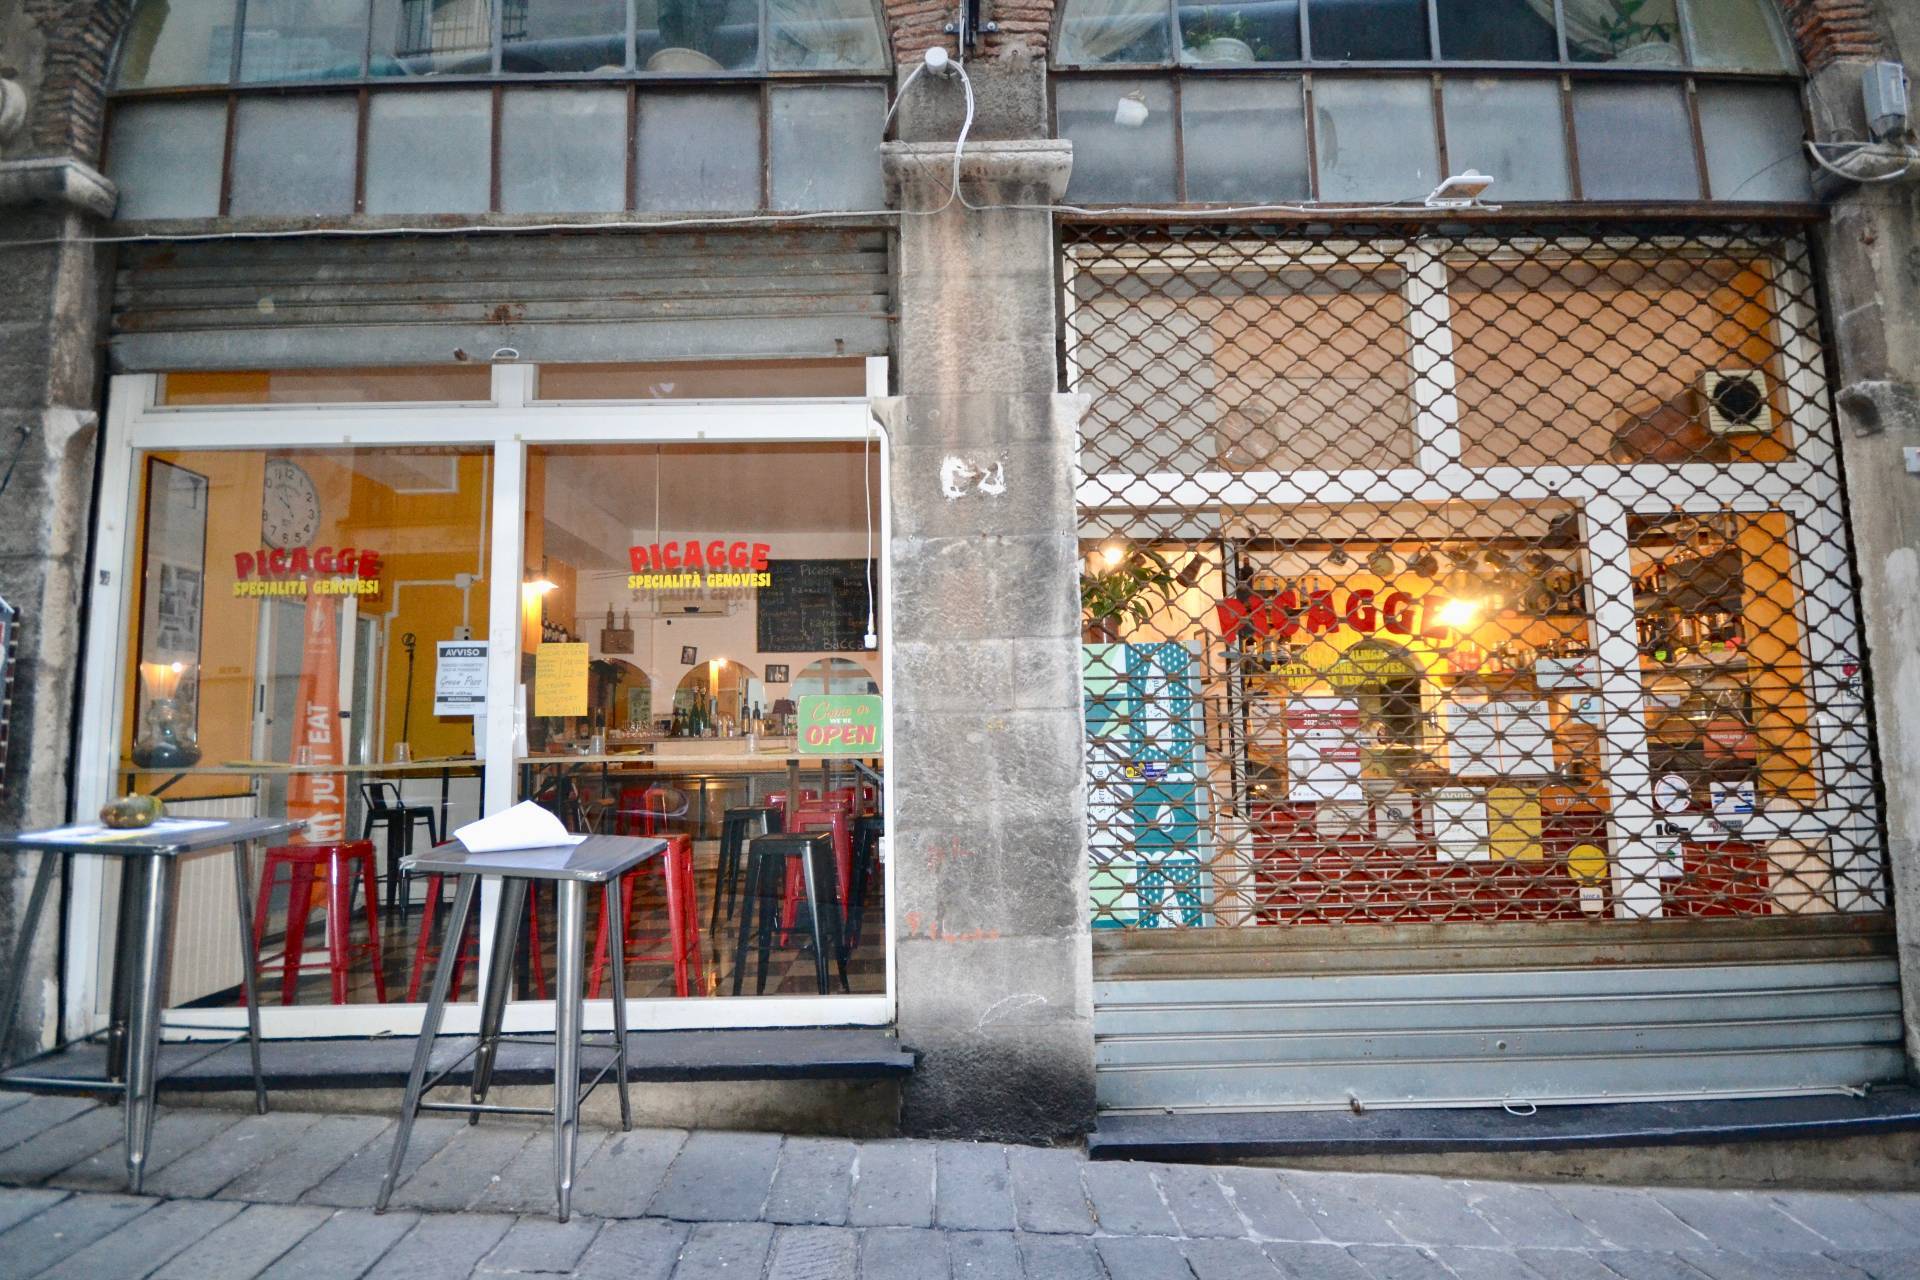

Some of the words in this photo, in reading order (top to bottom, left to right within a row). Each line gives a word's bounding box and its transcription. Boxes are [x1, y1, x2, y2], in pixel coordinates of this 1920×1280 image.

[304, 491, 313, 503] 2
[234, 546, 381, 579] PICAGGE
[628, 540, 771, 574] PICAGGE
[312, 579, 379, 595] GENOVESI
[628, 571, 701, 589] SPECIALITÀ
[706, 572, 771, 588] GENOVESI
[445, 648, 480, 657] AVVISO
[307, 700, 331, 744] EAT
[805, 723, 877, 746] OPEN
[310, 752, 339, 804] JUT
